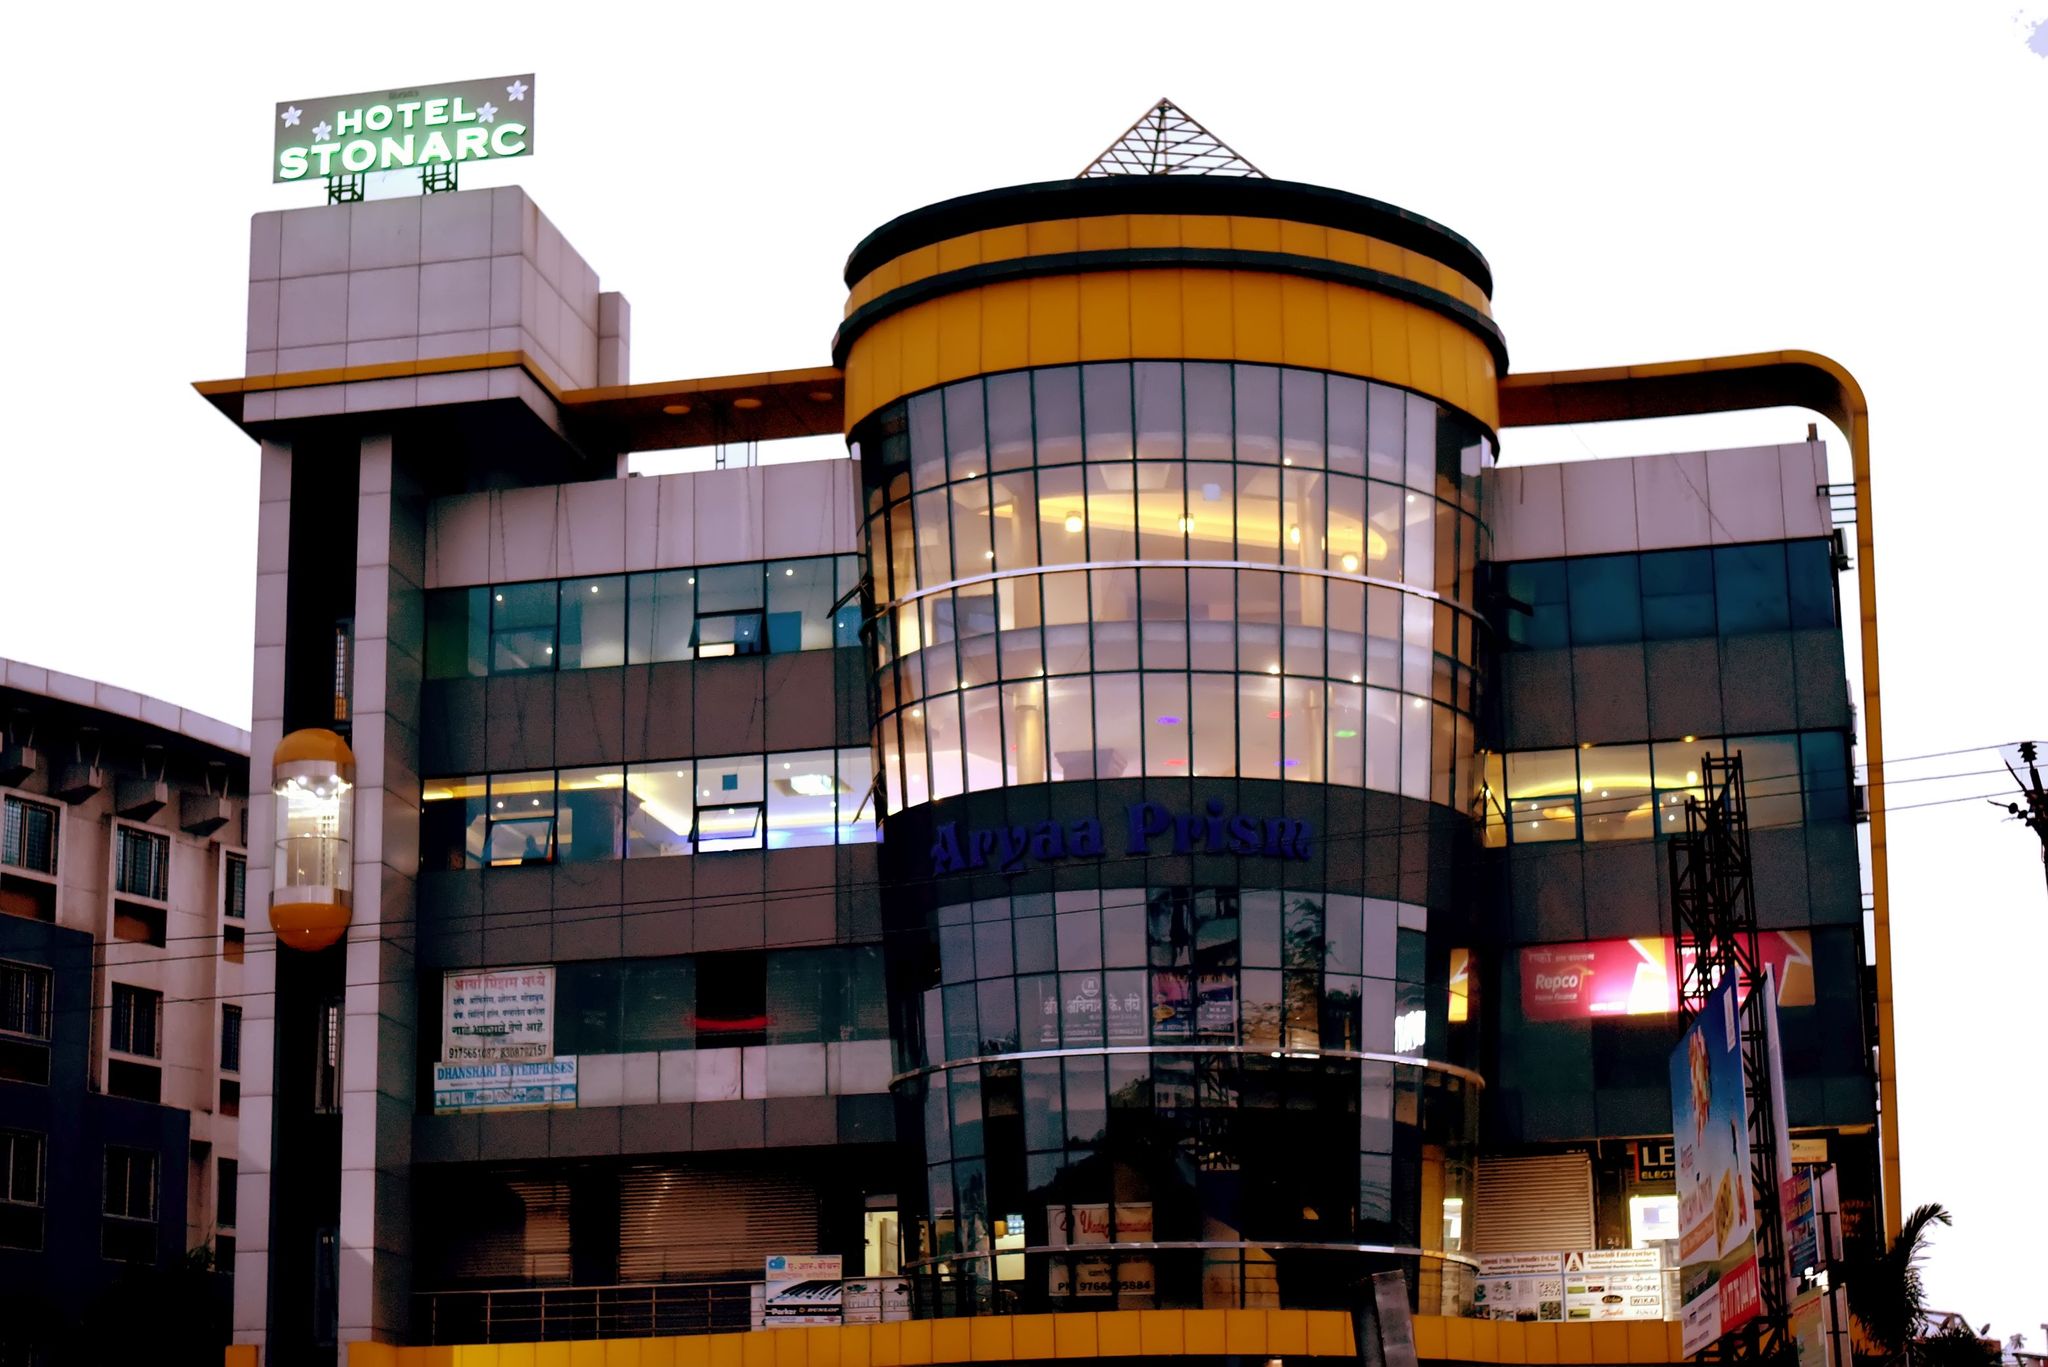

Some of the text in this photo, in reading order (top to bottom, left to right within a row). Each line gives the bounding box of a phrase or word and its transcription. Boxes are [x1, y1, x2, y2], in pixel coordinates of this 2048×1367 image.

[337, 97, 477, 136] HOTEL
[279, 122, 527, 180] STONARC
[930, 796, 1315, 875] Aryaa Prism
[1535, 973, 1578, 992] Repco
[501, 1062, 574, 1077] ENTERPRISES
[1633, 1296, 1656, 1304] WIKA
[771, 1307, 797, 1315] Parker
